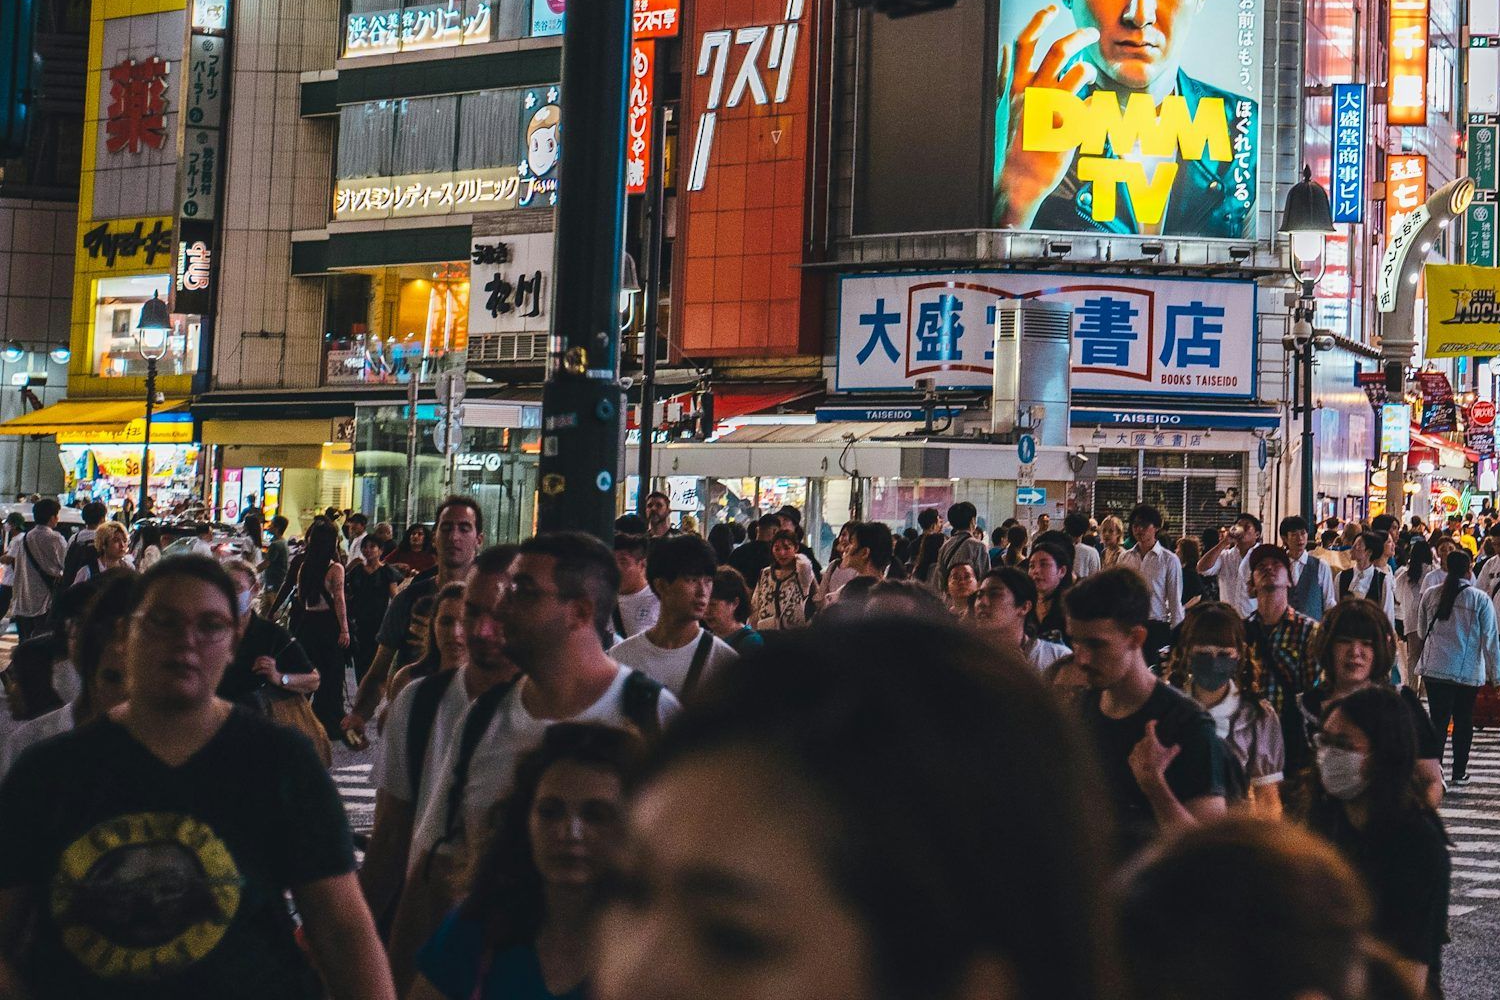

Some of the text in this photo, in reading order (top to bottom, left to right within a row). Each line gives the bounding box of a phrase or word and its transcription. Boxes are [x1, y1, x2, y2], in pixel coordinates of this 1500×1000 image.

[1471, 37, 1486, 47] 3F
[627, 47, 653, 189] もんじゃ焼
[1022, 86, 1234, 163] DMM
[1470, 114, 1485, 124] 2F
[1337, 91, 1361, 217] 大盛堂商事ビル
[1076, 156, 1179, 226] TV
[1380, 210, 1422, 307] 渋谷センター街
[1472, 289, 1494, 302] SUN
[855, 293, 1226, 370] 大盛書店
[1160, 373, 1239, 388] BOOKS TAISEIDO
[865, 409, 912, 421] TAISEIDO
[1111, 412, 1182, 425] TAISEIDO
[1116, 431, 1202, 448] 大盛堂書店
